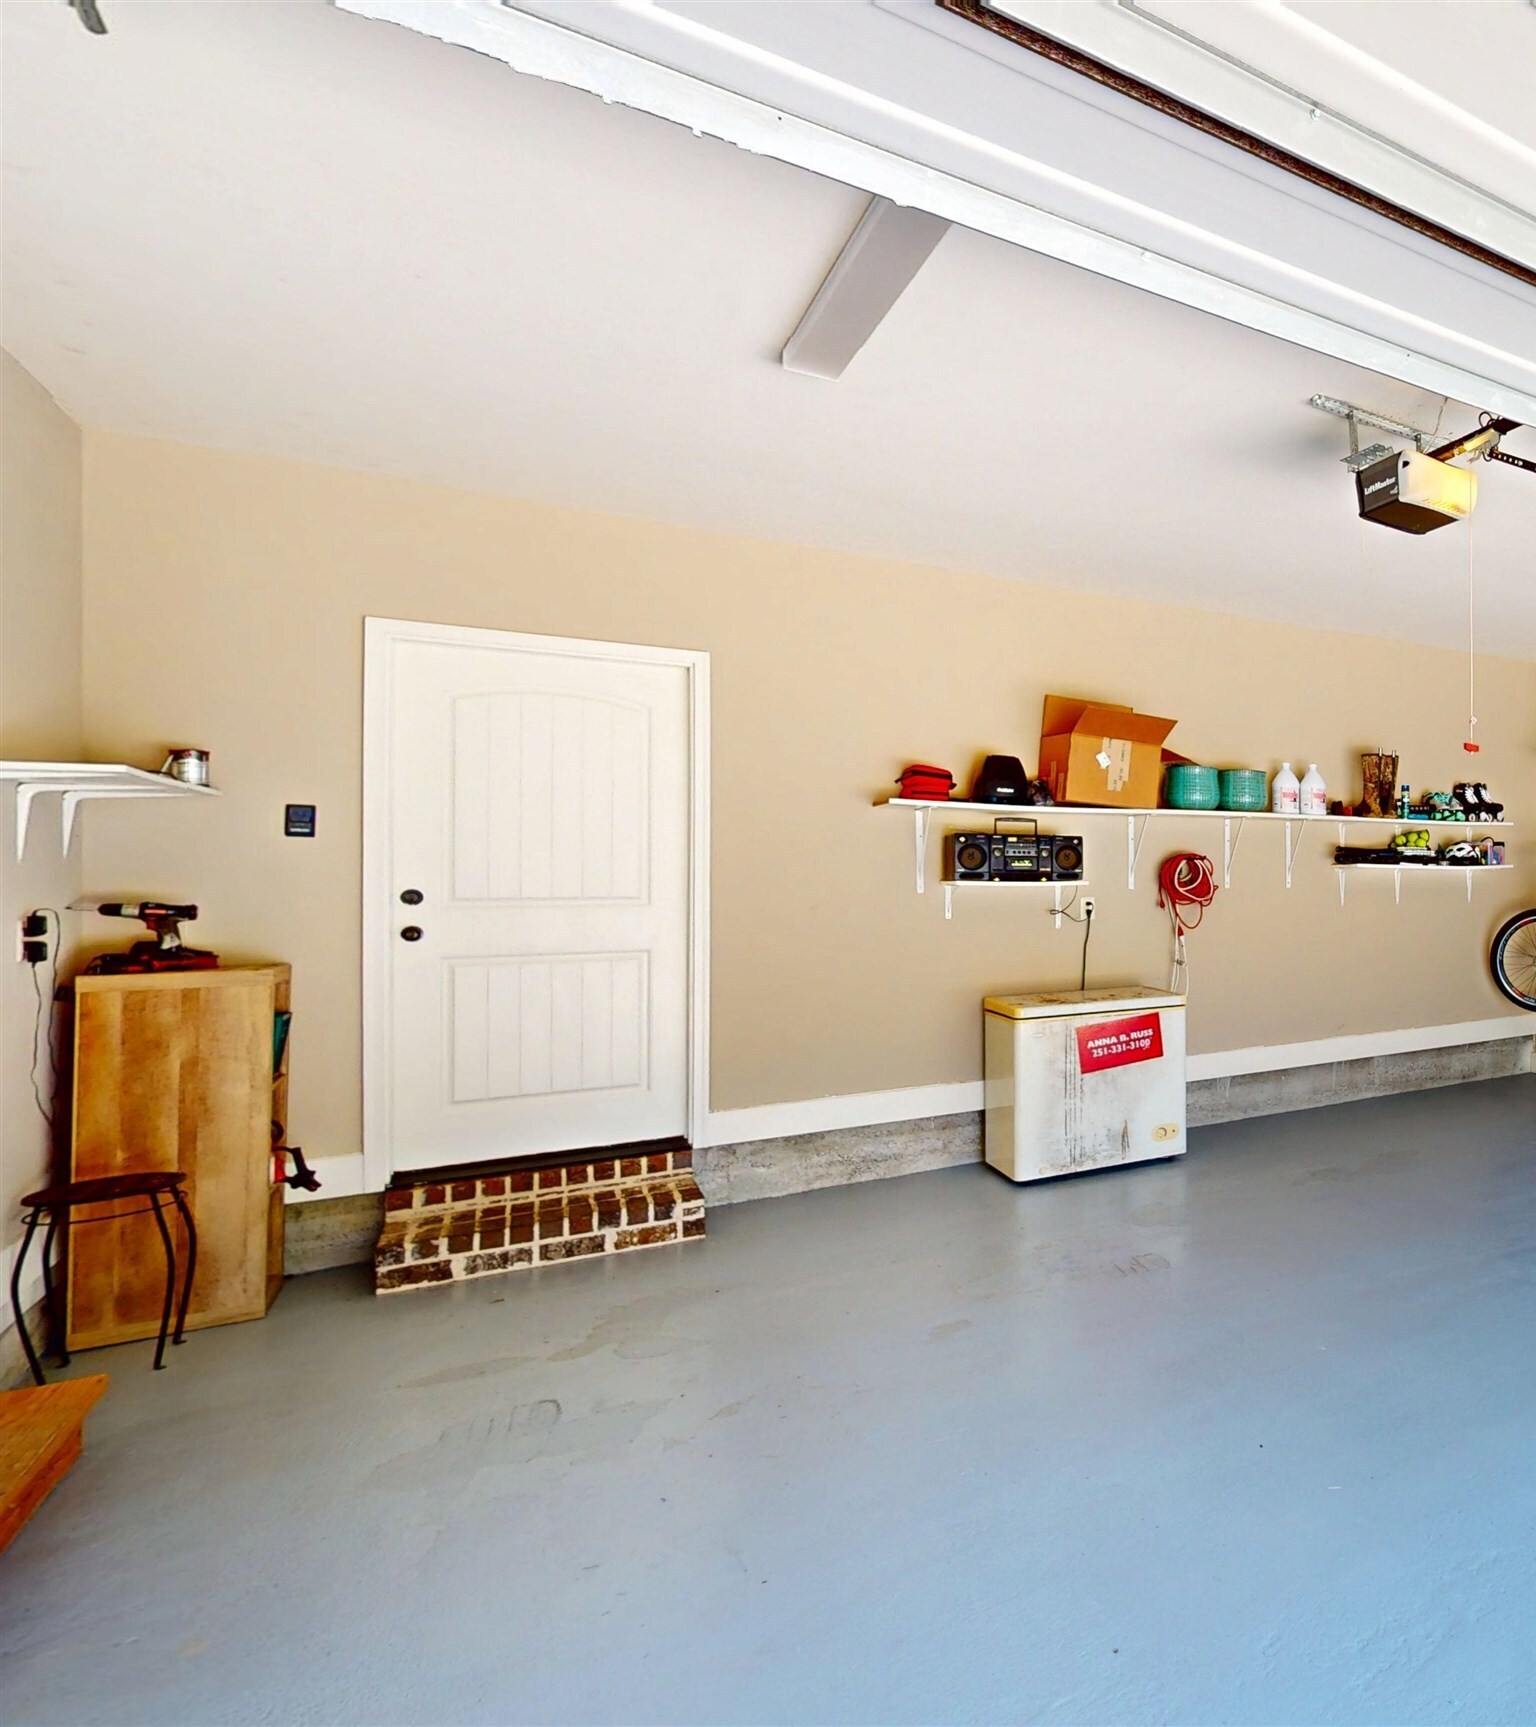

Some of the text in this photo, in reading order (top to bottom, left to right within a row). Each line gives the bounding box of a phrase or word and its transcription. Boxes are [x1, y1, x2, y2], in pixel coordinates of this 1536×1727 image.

[1364, 476, 1396, 495] LiftMaster
[1087, 1028, 1154, 1048] ANNA B. RUSS
